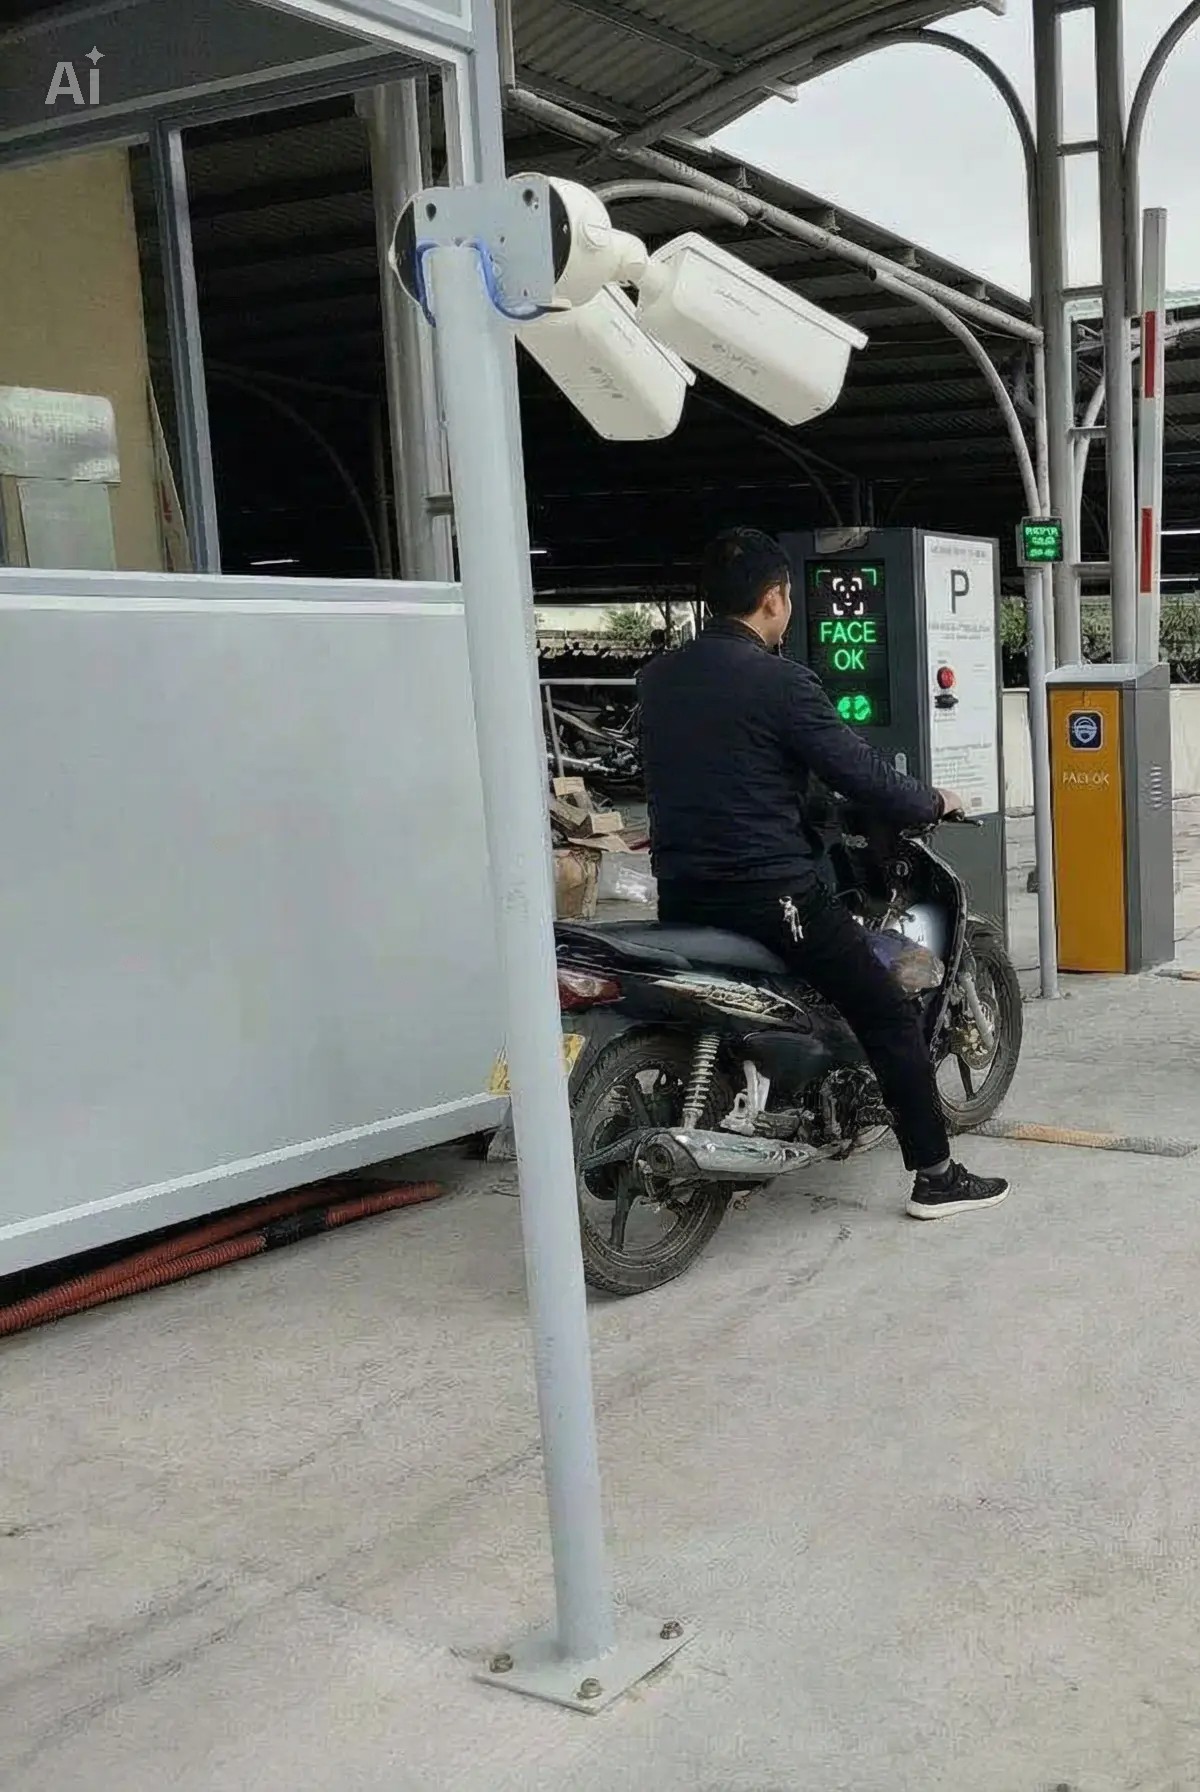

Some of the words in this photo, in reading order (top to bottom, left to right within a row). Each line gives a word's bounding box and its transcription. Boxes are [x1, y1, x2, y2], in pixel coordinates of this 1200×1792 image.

[950, 569, 969, 614] P
[820, 621, 877, 643] FACE
[834, 649, 865, 671] OK
